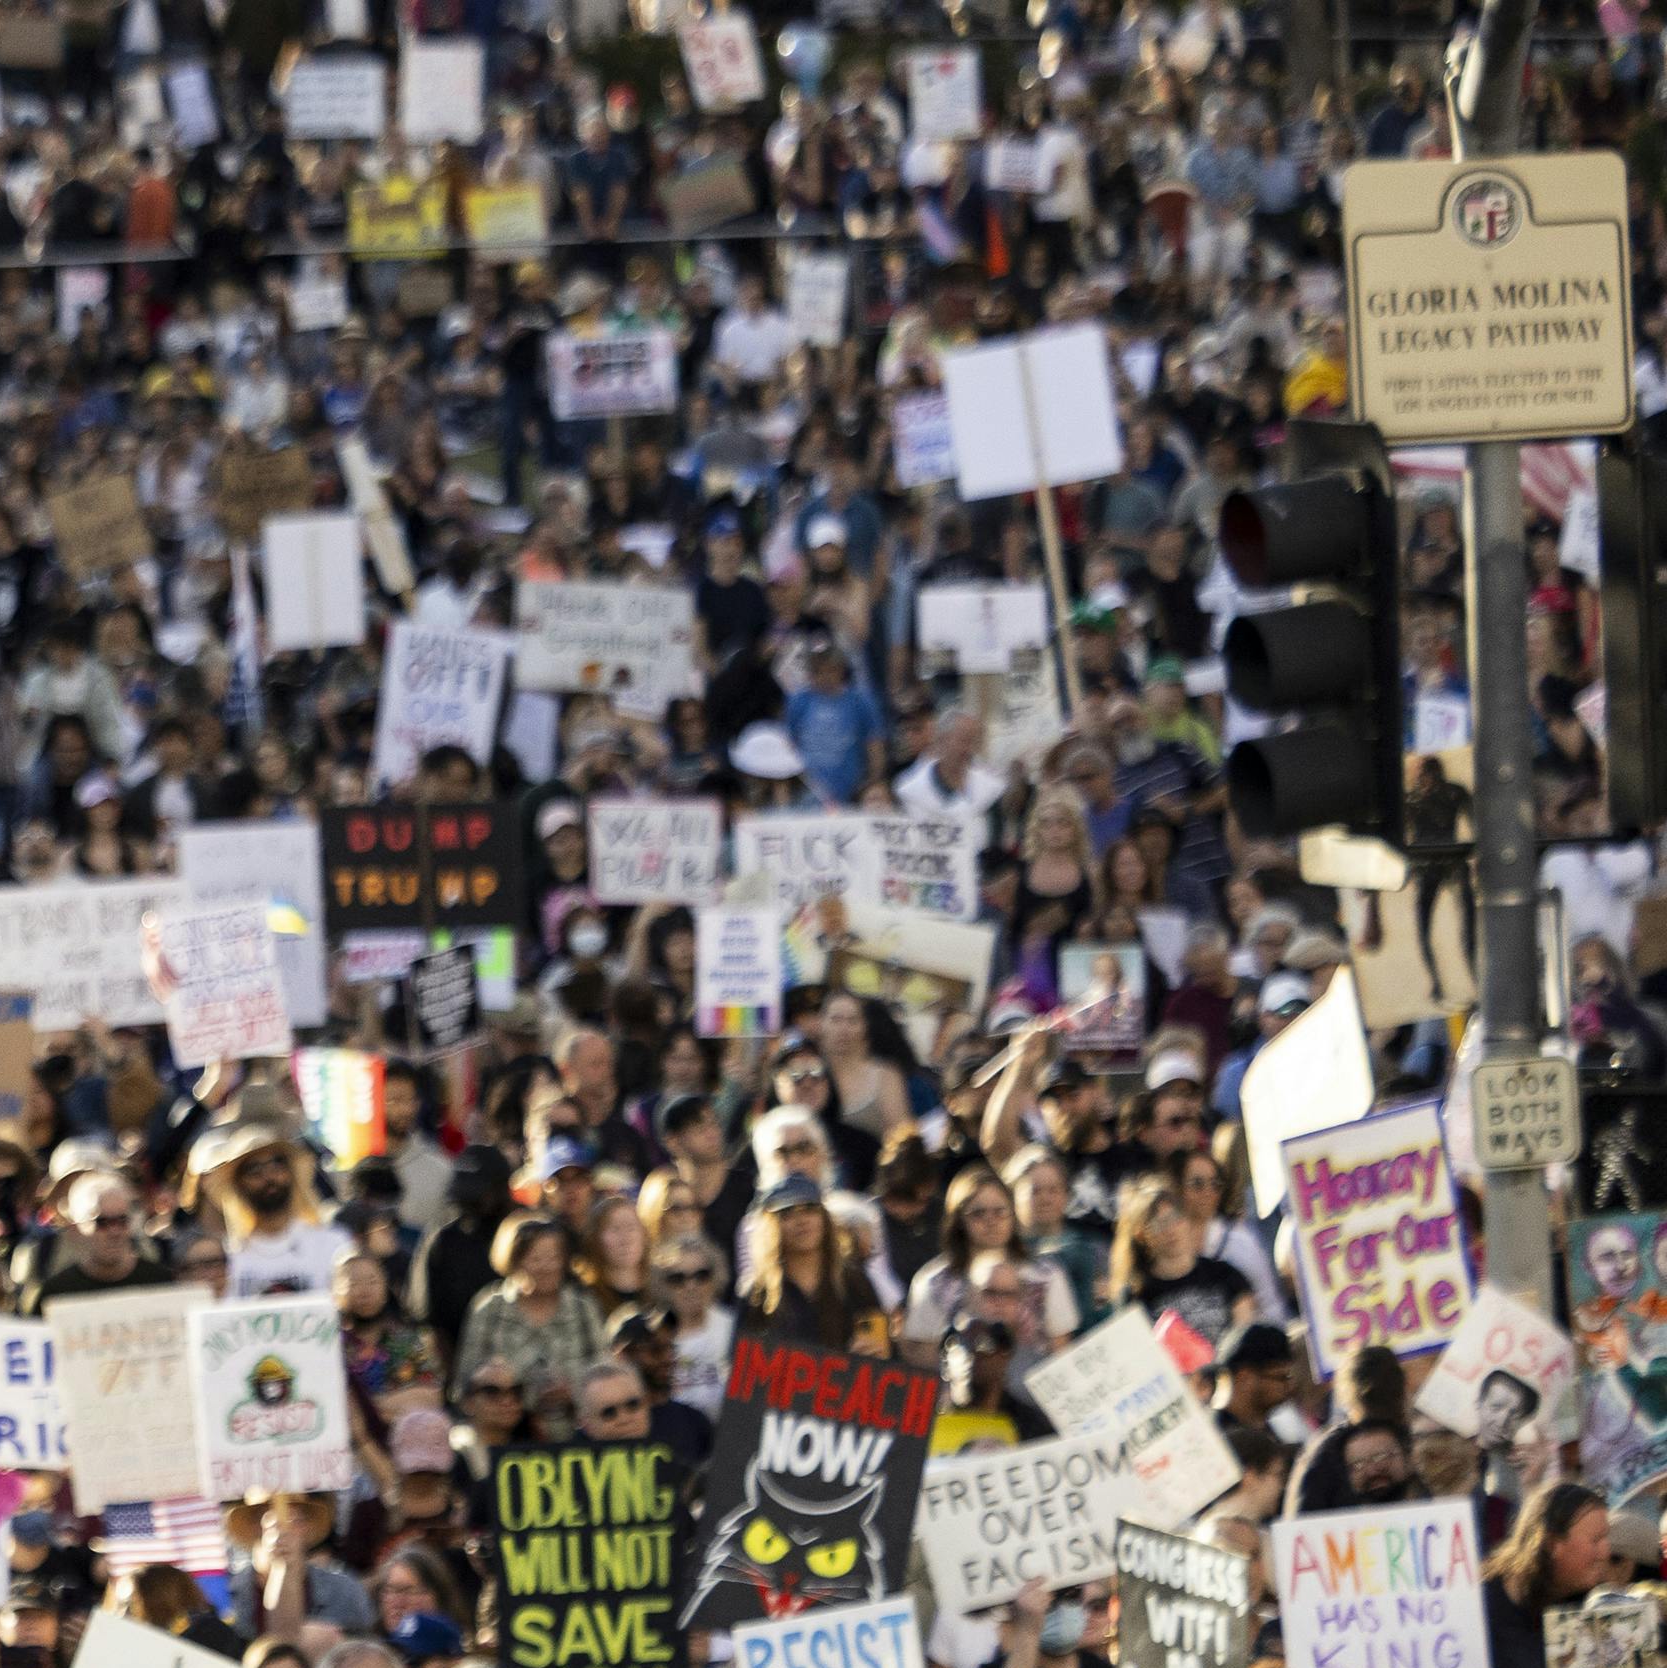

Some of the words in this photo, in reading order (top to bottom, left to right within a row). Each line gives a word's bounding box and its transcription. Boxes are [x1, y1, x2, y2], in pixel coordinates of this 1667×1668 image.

[1368, 283, 1479, 317] GLORIA
[1492, 278, 1610, 310] MOLINA
[1380, 326, 1477, 354] LEGACY
[1487, 319, 1604, 347] PATHWAY
[1487, 1072, 1558, 1096] LOOK
[1489, 1101, 1561, 1125] BOTH
[1489, 1127, 1563, 1151] WAYS
[1293, 1145, 1442, 1224] Hooray
[1331, 1278, 1461, 1351] Side
[725, 1335, 939, 1438] IMPEACH
[759, 1411, 894, 1486] NOW!
[922, 1440, 1134, 1521] FREEDOM
[497, 1452, 675, 1532] OBEYING
[980, 1492, 1092, 1545] OVER
[500, 1533, 590, 1597] WILL
[593, 1526, 674, 1592] NOT
[1291, 1520, 1473, 1598] AMERICA
[510, 1598, 674, 1668] SAVE
[1317, 1600, 1381, 1636] HAS
[1396, 1594, 1446, 1627] NO
